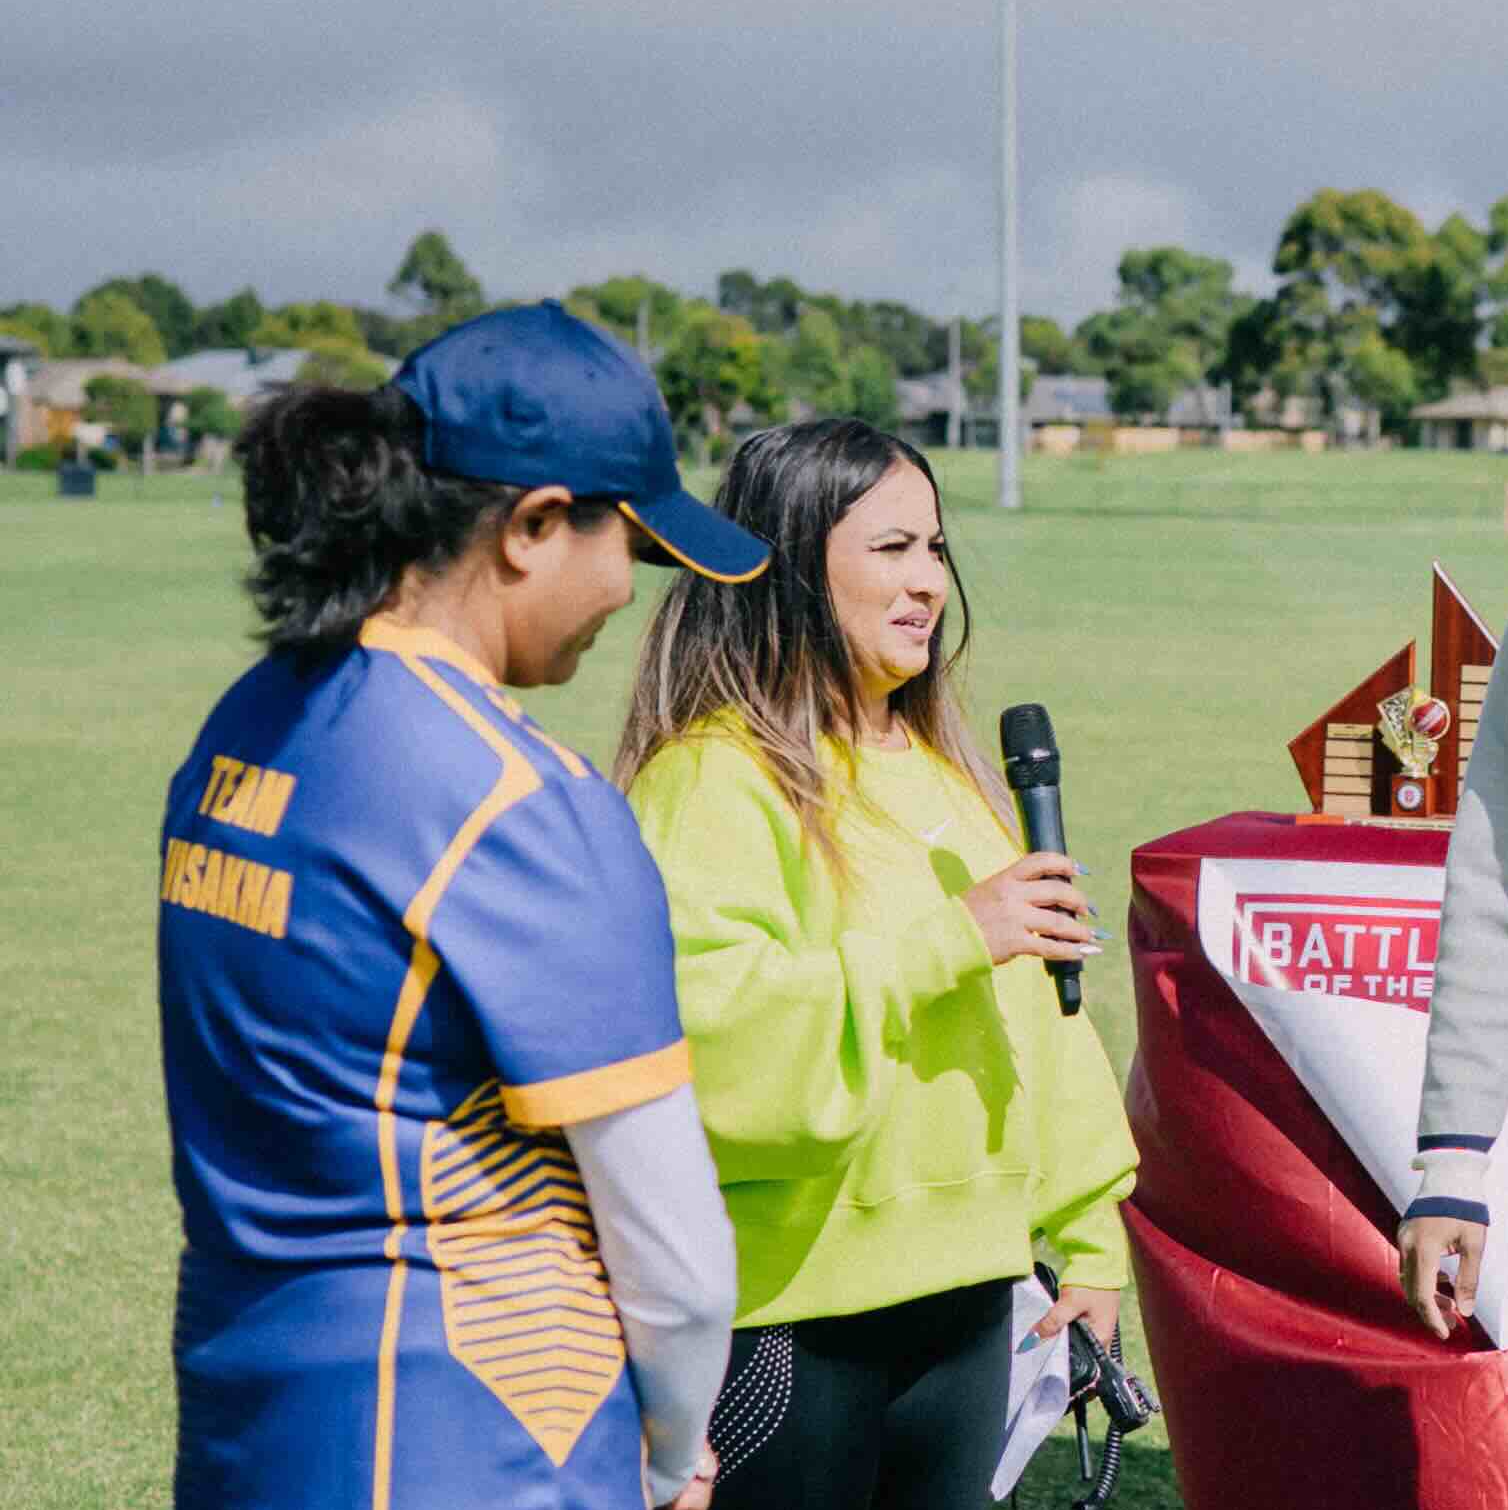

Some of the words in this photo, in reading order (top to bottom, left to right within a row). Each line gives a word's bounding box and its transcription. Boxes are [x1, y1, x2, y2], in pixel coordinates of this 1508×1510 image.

[198, 754, 297, 838] TEAM
[1262, 921, 1436, 971] BATTL
[1303, 974, 1353, 995] OF
[1363, 975, 1434, 998] THE
